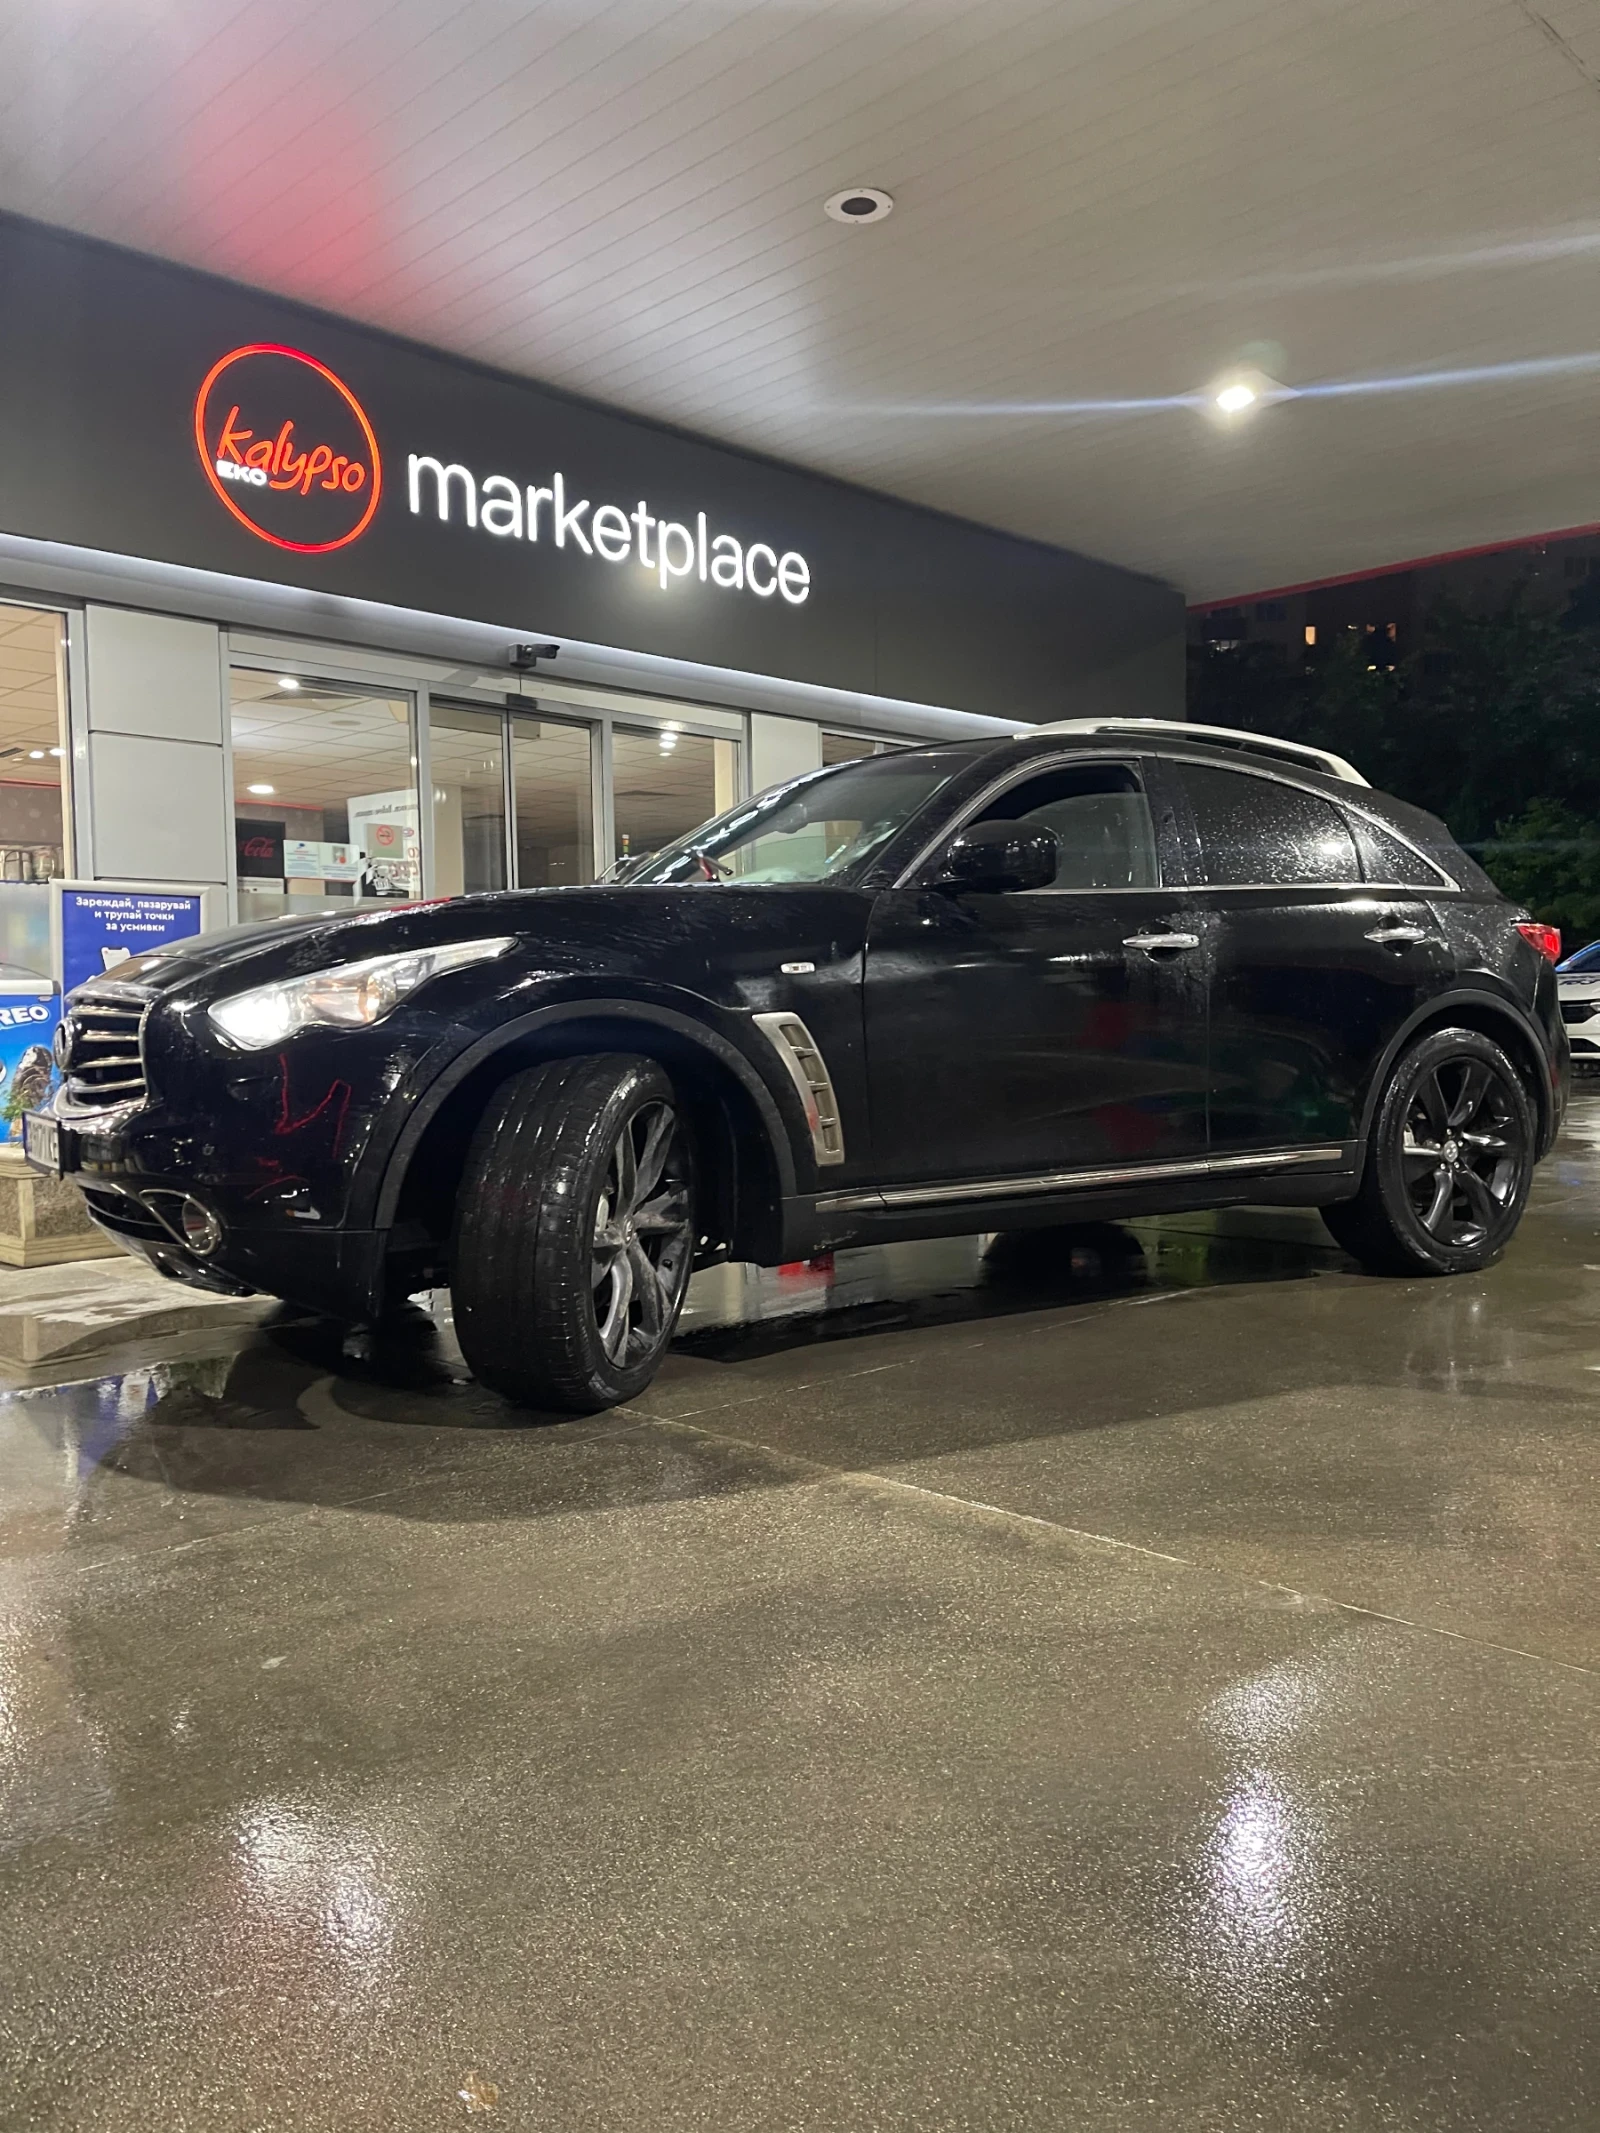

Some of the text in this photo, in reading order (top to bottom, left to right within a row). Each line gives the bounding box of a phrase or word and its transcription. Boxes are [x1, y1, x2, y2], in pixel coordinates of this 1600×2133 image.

[215, 459, 268, 487] EKO
[407, 453, 811, 604] marketplace
[75, 896, 191, 911] Зареждай, пазарувай
[104, 910, 142, 921] трупай
[144, 912, 175, 921] точки
[105, 922, 165, 932] за усмивки
